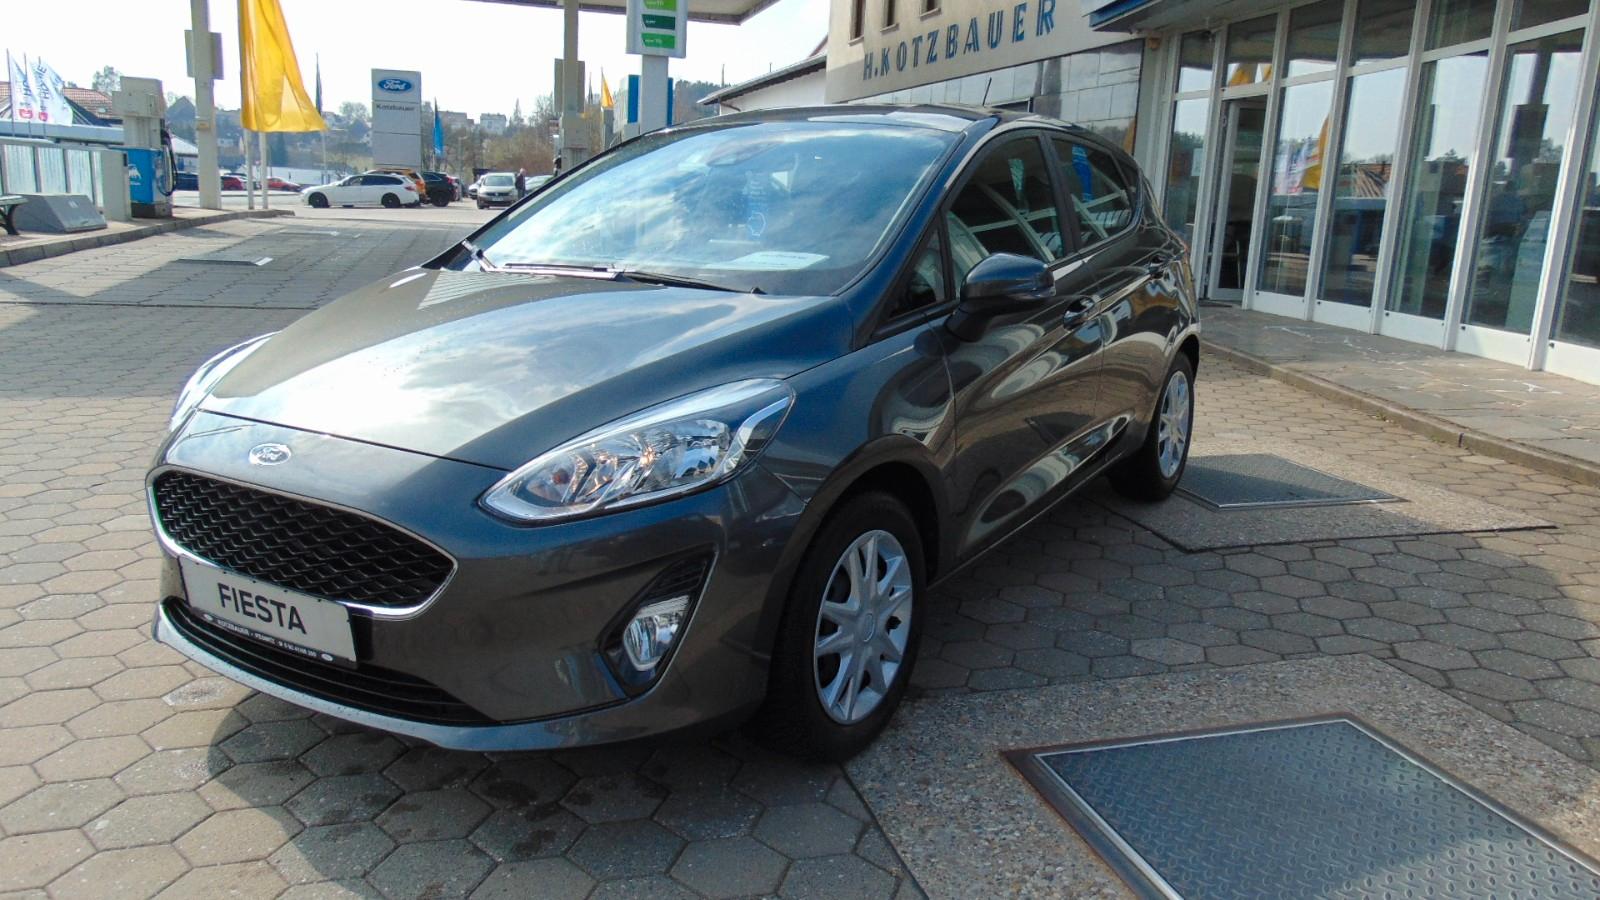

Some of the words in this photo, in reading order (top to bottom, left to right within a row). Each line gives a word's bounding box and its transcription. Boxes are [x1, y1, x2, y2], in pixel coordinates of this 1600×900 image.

[381, 79, 409, 91] Ford
[253, 446, 287, 463] Ford
[217, 582, 307, 635] FIESTA
